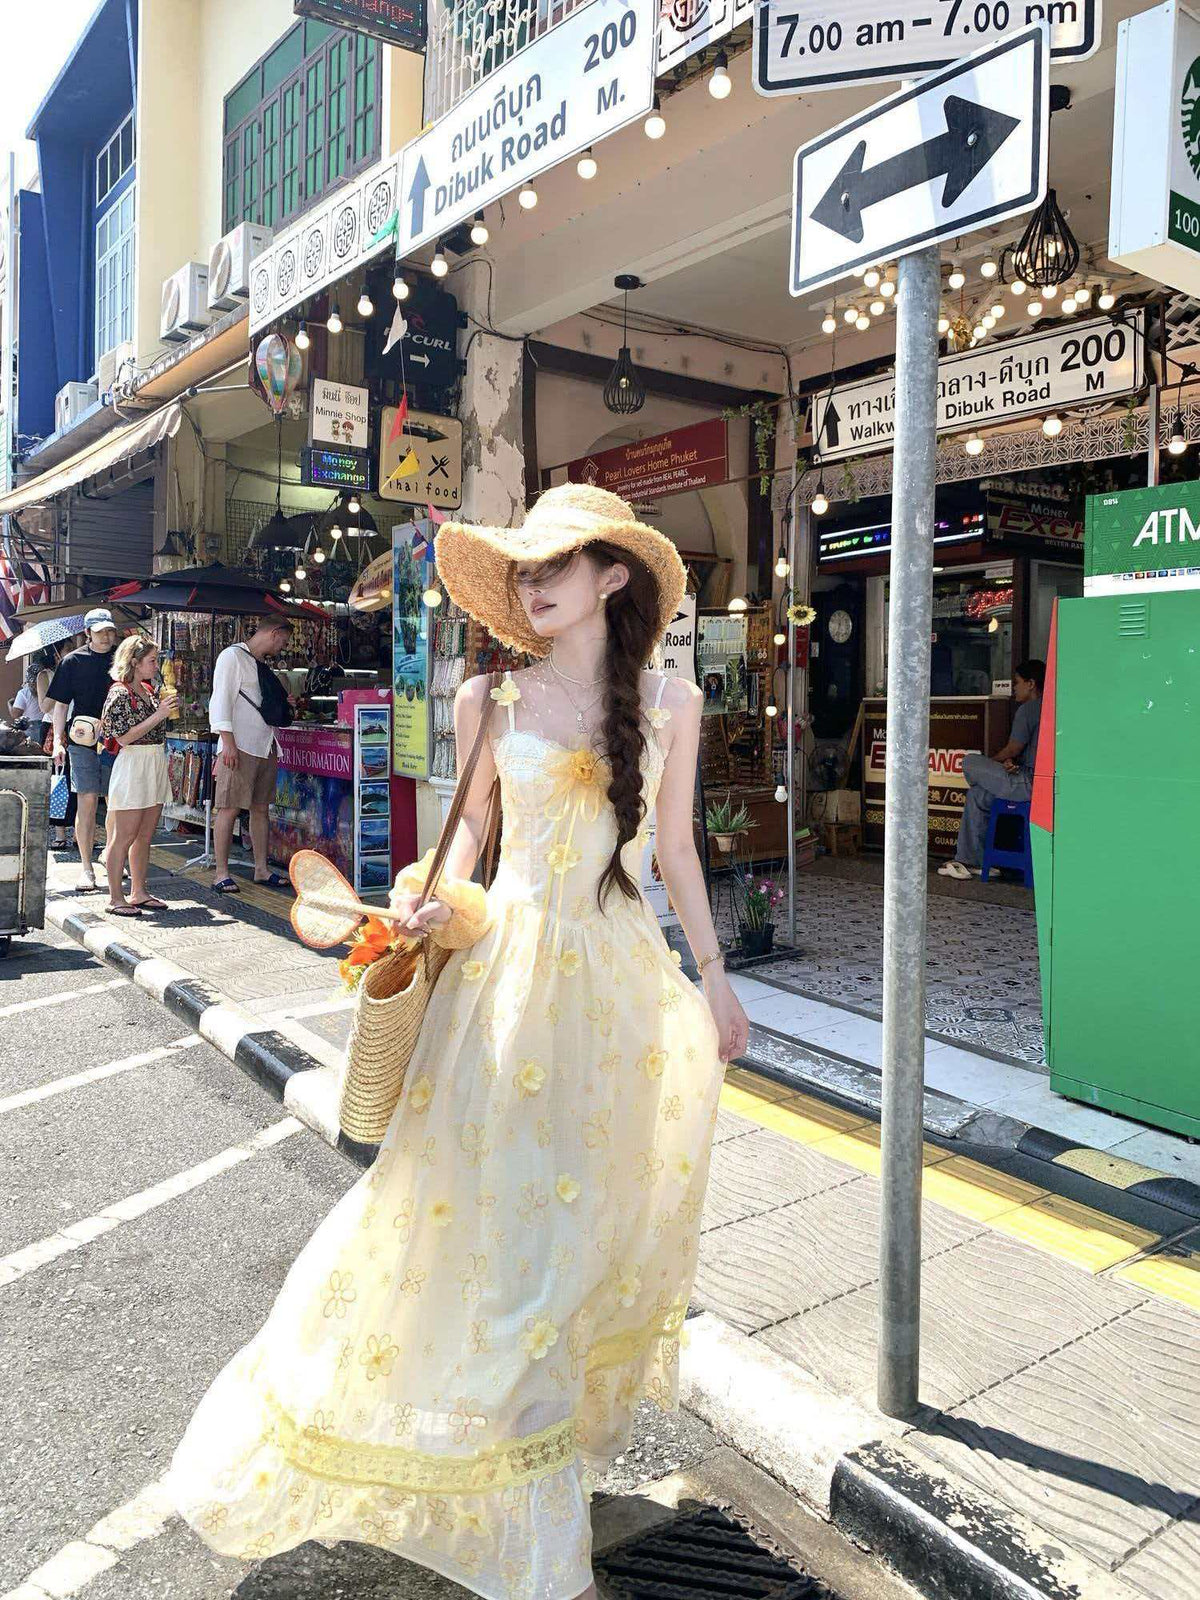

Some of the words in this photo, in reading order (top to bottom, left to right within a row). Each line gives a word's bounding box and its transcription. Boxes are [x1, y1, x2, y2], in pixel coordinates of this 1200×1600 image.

[583, 9, 637, 74] 200
[776, 13, 842, 58] 7.00
[856, 18, 904, 47] am
[943, 0, 1009, 36] 7.00
[1025, 1, 1077, 25] pm
[596, 77, 626, 115] M.
[451, 73, 542, 163] ถนนดีบุก
[434, 151, 494, 216] Dibuk
[501, 100, 567, 172] Road
[412, 334, 452, 351] CURL
[1060, 329, 1126, 374] 200
[1086, 371, 1105, 391] M
[945, 398, 995, 420] Dibuk
[1003, 382, 1050, 407] Road
[315, 406, 343, 419] Minnie
[345, 411, 367, 426] Shop
[313, 466, 365, 484] Exchange
[322, 454, 357, 470] Money
[605, 468, 622, 482] Pearl
[624, 463, 646, 478] Lovers
[648, 458, 669, 473] Home
[671, 450, 698, 466] Phuket
[426, 482, 458, 500] food
[1031, 504, 1069, 518] MONEY
[1132, 507, 1200, 547] ATM
[665, 631, 692, 647] Road
[293, 746, 350, 773] INFORMATION
